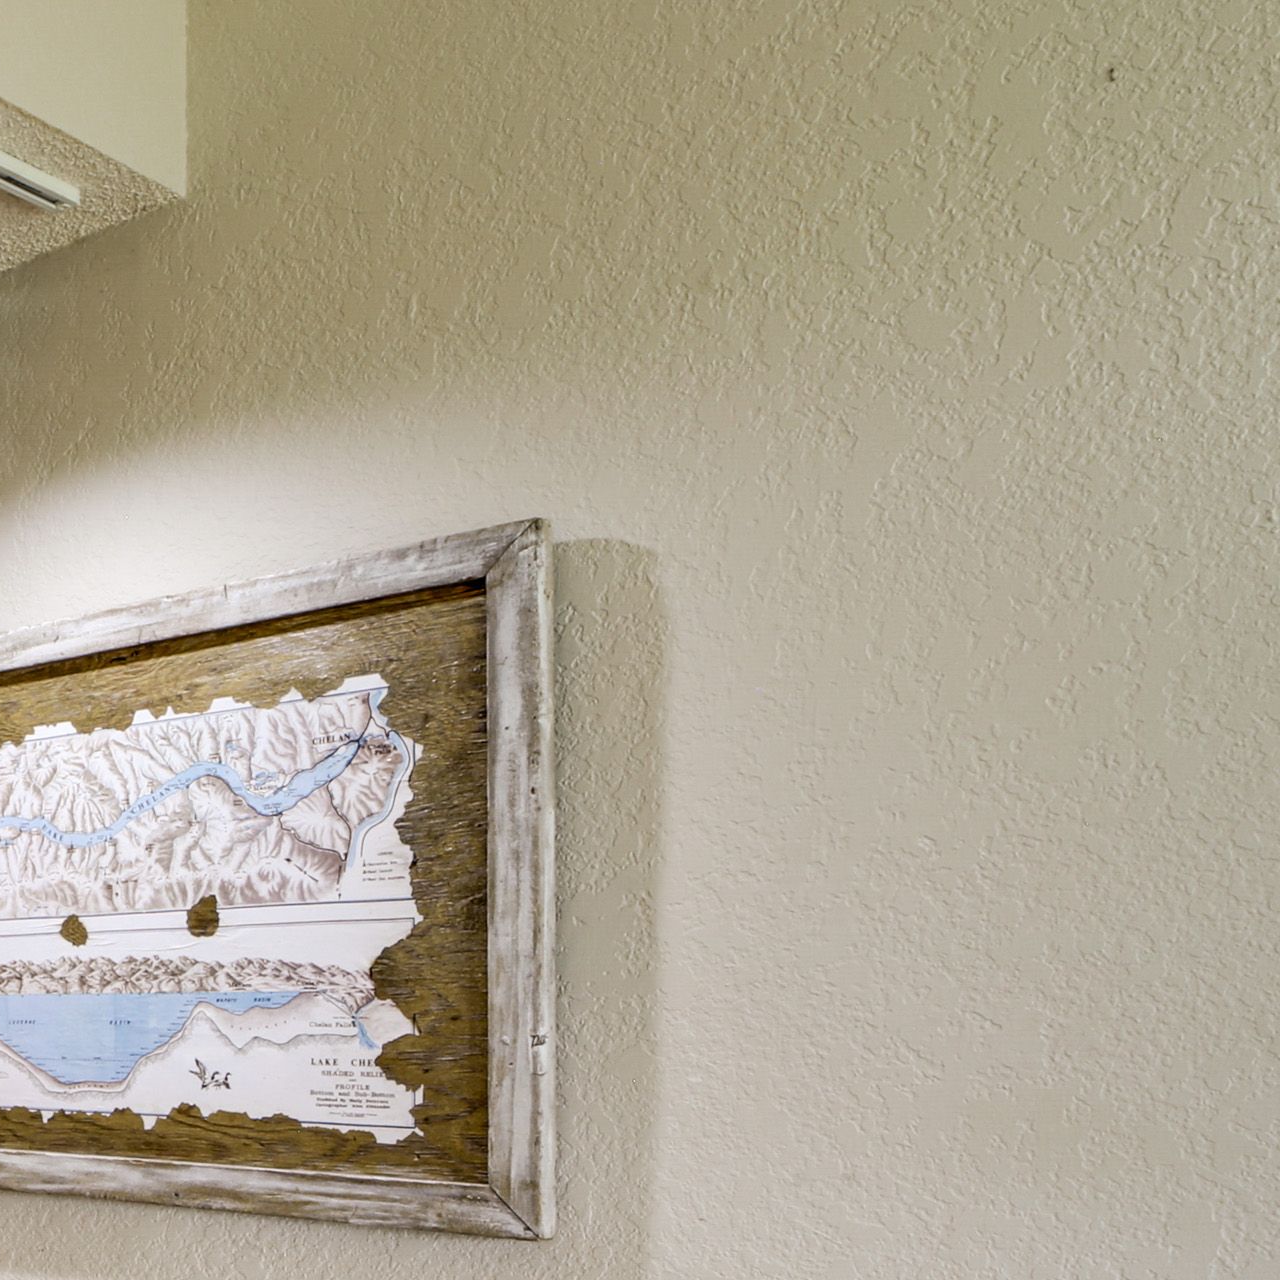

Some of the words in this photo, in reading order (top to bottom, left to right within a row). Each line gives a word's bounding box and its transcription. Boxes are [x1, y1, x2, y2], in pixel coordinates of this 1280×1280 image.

[312, 732, 351, 745] CHELAN
[130, 787, 171, 815] CHELAN
[310, 1057, 340, 1067] LAKE
[335, 1083, 371, 1091] PROFILE
